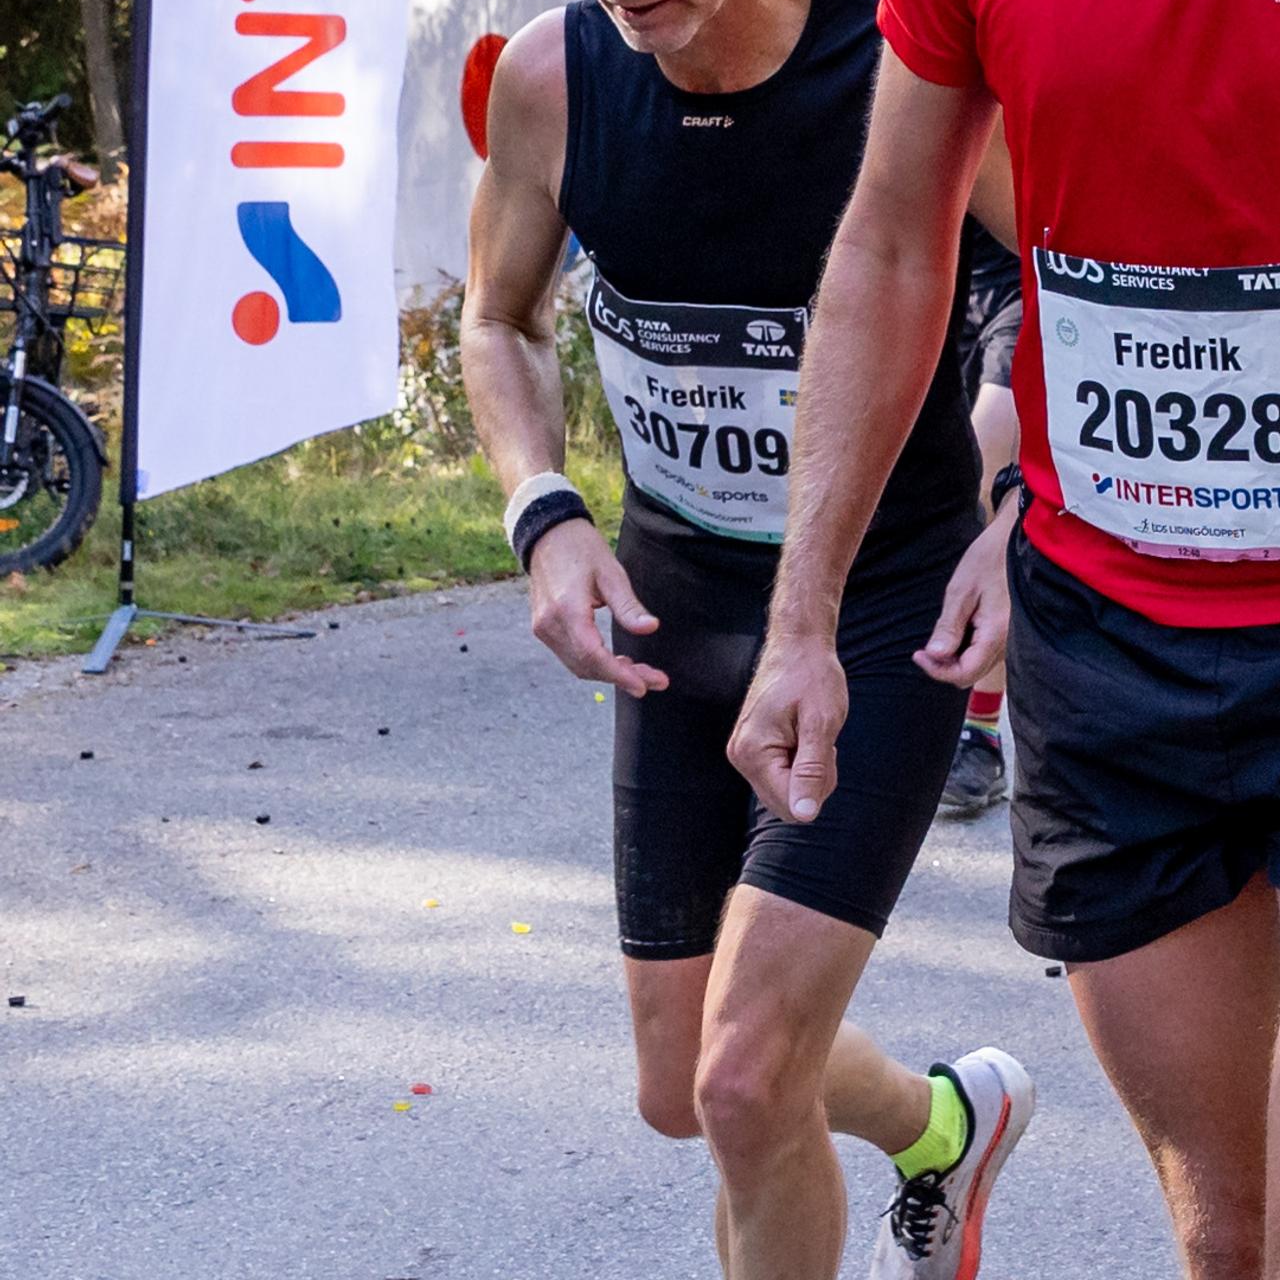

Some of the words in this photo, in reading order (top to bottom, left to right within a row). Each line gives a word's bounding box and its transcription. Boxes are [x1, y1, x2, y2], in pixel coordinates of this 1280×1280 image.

[682, 116, 723, 127] CRAFT
[1111, 273, 1176, 292] SERVICES
[594, 291, 636, 342] tcs
[635, 318, 672, 333] TATA
[637, 328, 722, 345] CONSULTANCY
[640, 339, 693, 354] SERVICES
[741, 342, 796, 358] TATA
[1113, 332, 1243, 372] Fredrik
[646, 375, 747, 410] Fredrik
[624, 395, 791, 477] 30709
[712, 489, 769, 504] sports
[1169, 525, 1247, 539] LIDINGÖLOPPET
[1263, 550, 1269, 558] 2
